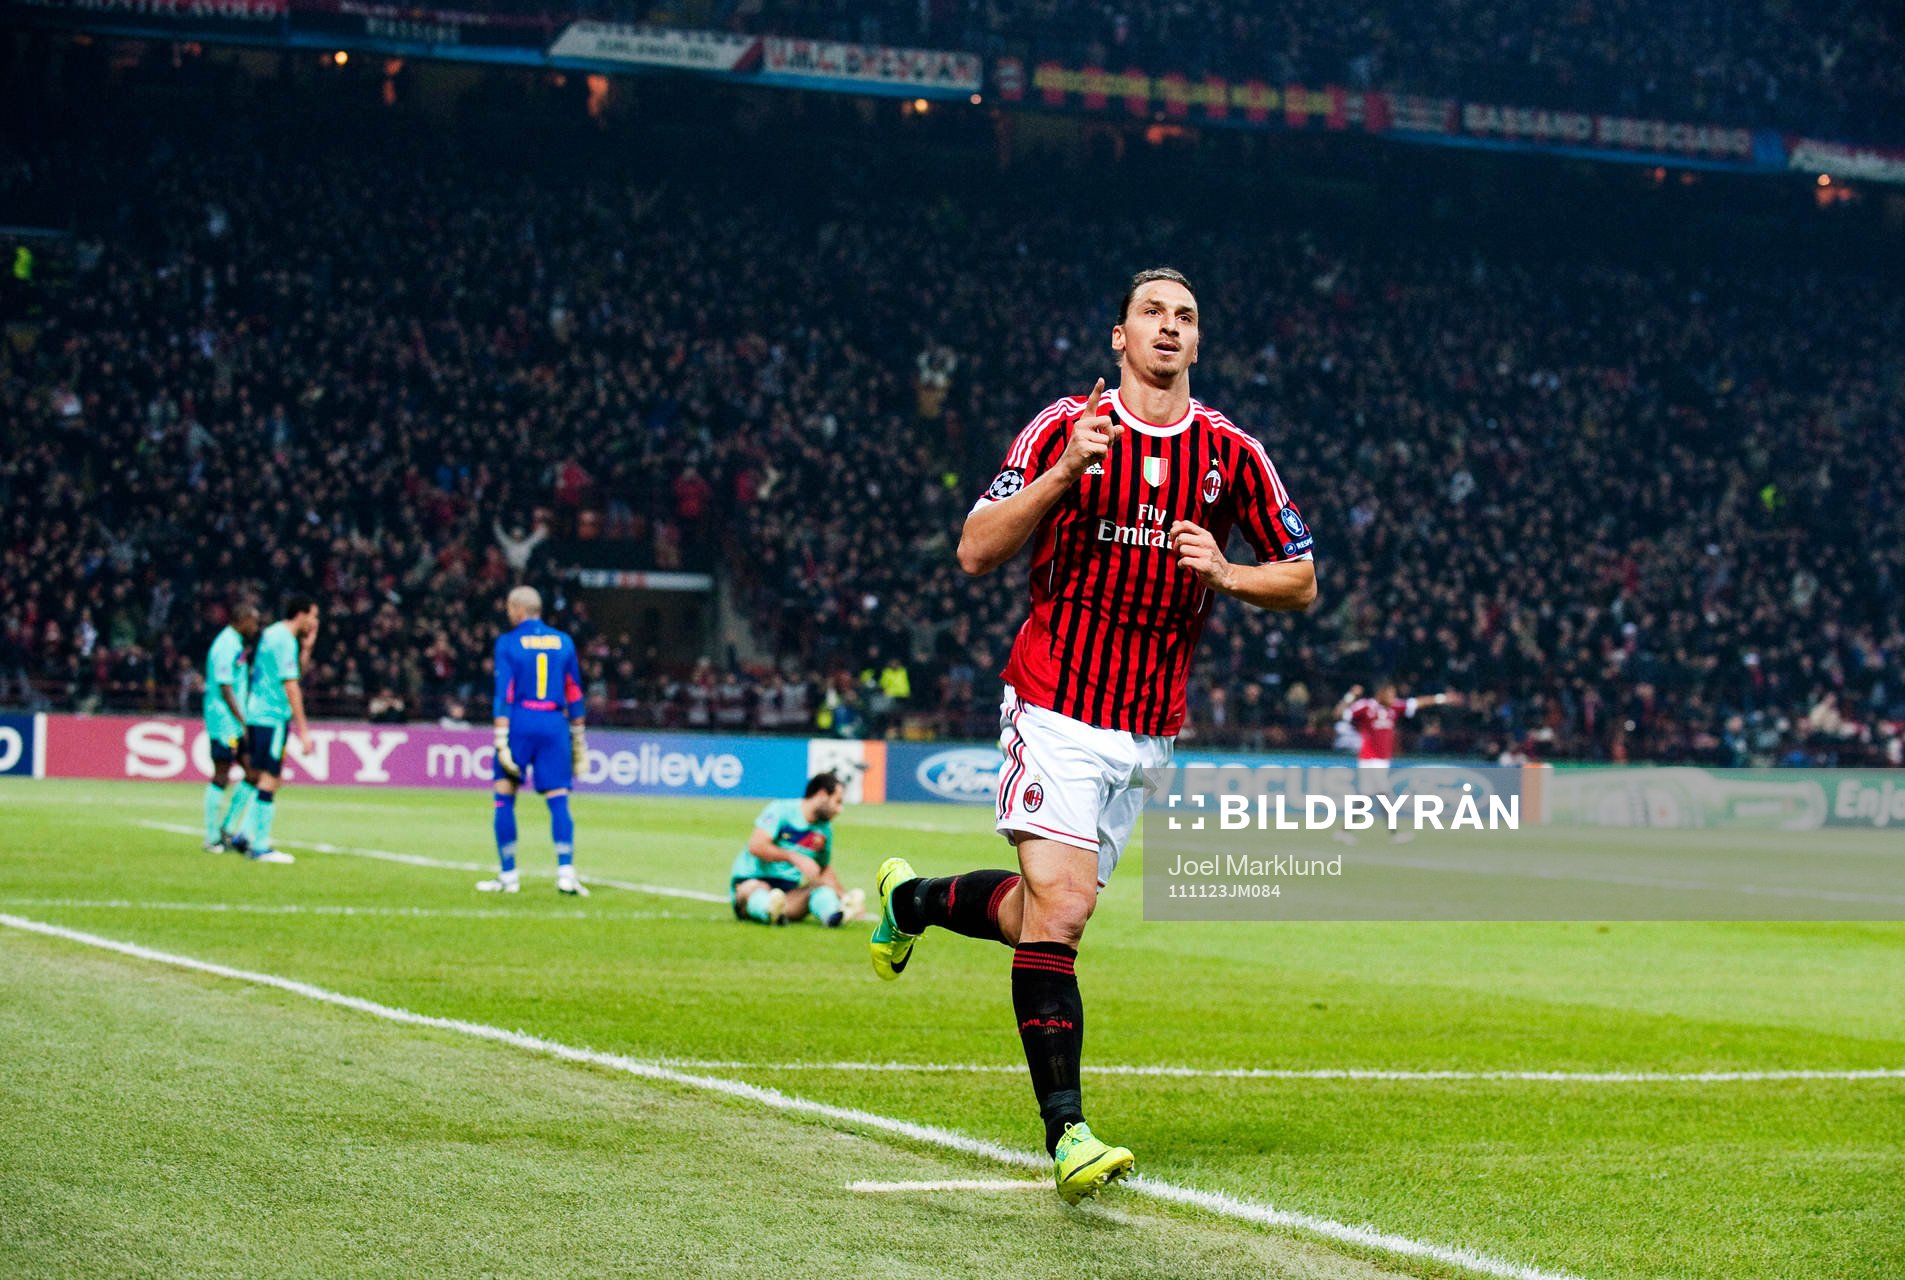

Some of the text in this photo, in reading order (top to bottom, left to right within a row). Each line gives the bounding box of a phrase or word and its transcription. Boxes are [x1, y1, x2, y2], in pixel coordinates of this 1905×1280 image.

[1138, 503, 1167, 525] Fly
[1098, 519, 1173, 550] Emira
[536, 652, 548, 700] 1
[1183, 762, 1357, 810] FOCUS
[1835, 779, 1905, 827] Enjo
[1022, 1018, 1073, 1030] MILAN
